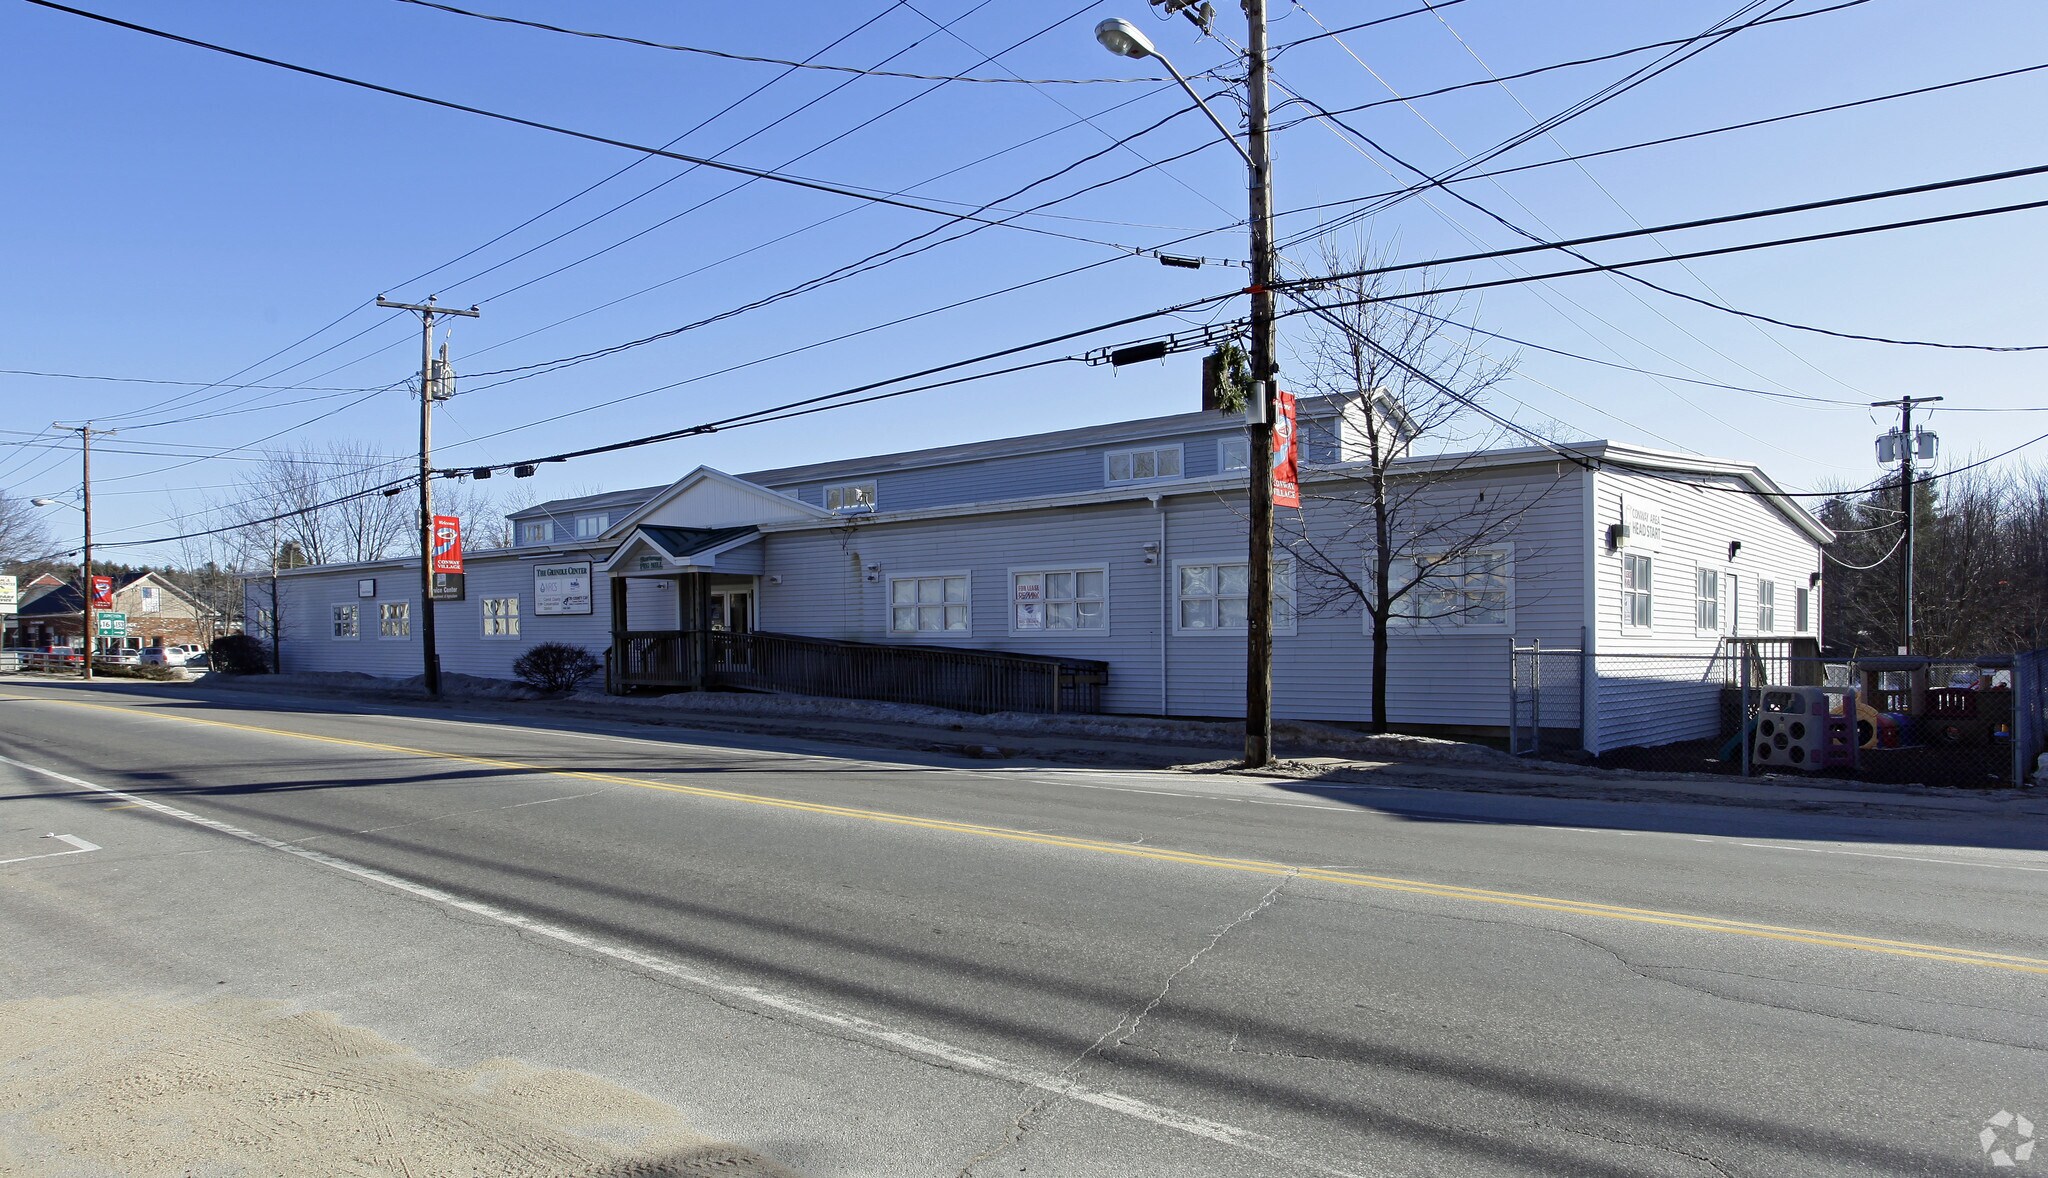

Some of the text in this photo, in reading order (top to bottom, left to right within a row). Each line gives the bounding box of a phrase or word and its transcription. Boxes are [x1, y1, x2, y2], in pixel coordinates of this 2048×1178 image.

[1632, 508, 1649, 522] CONWAY
[1632, 521, 1661, 540] HEAD START
[537, 569, 547, 577] THE
[568, 567, 588, 575] CENTER
